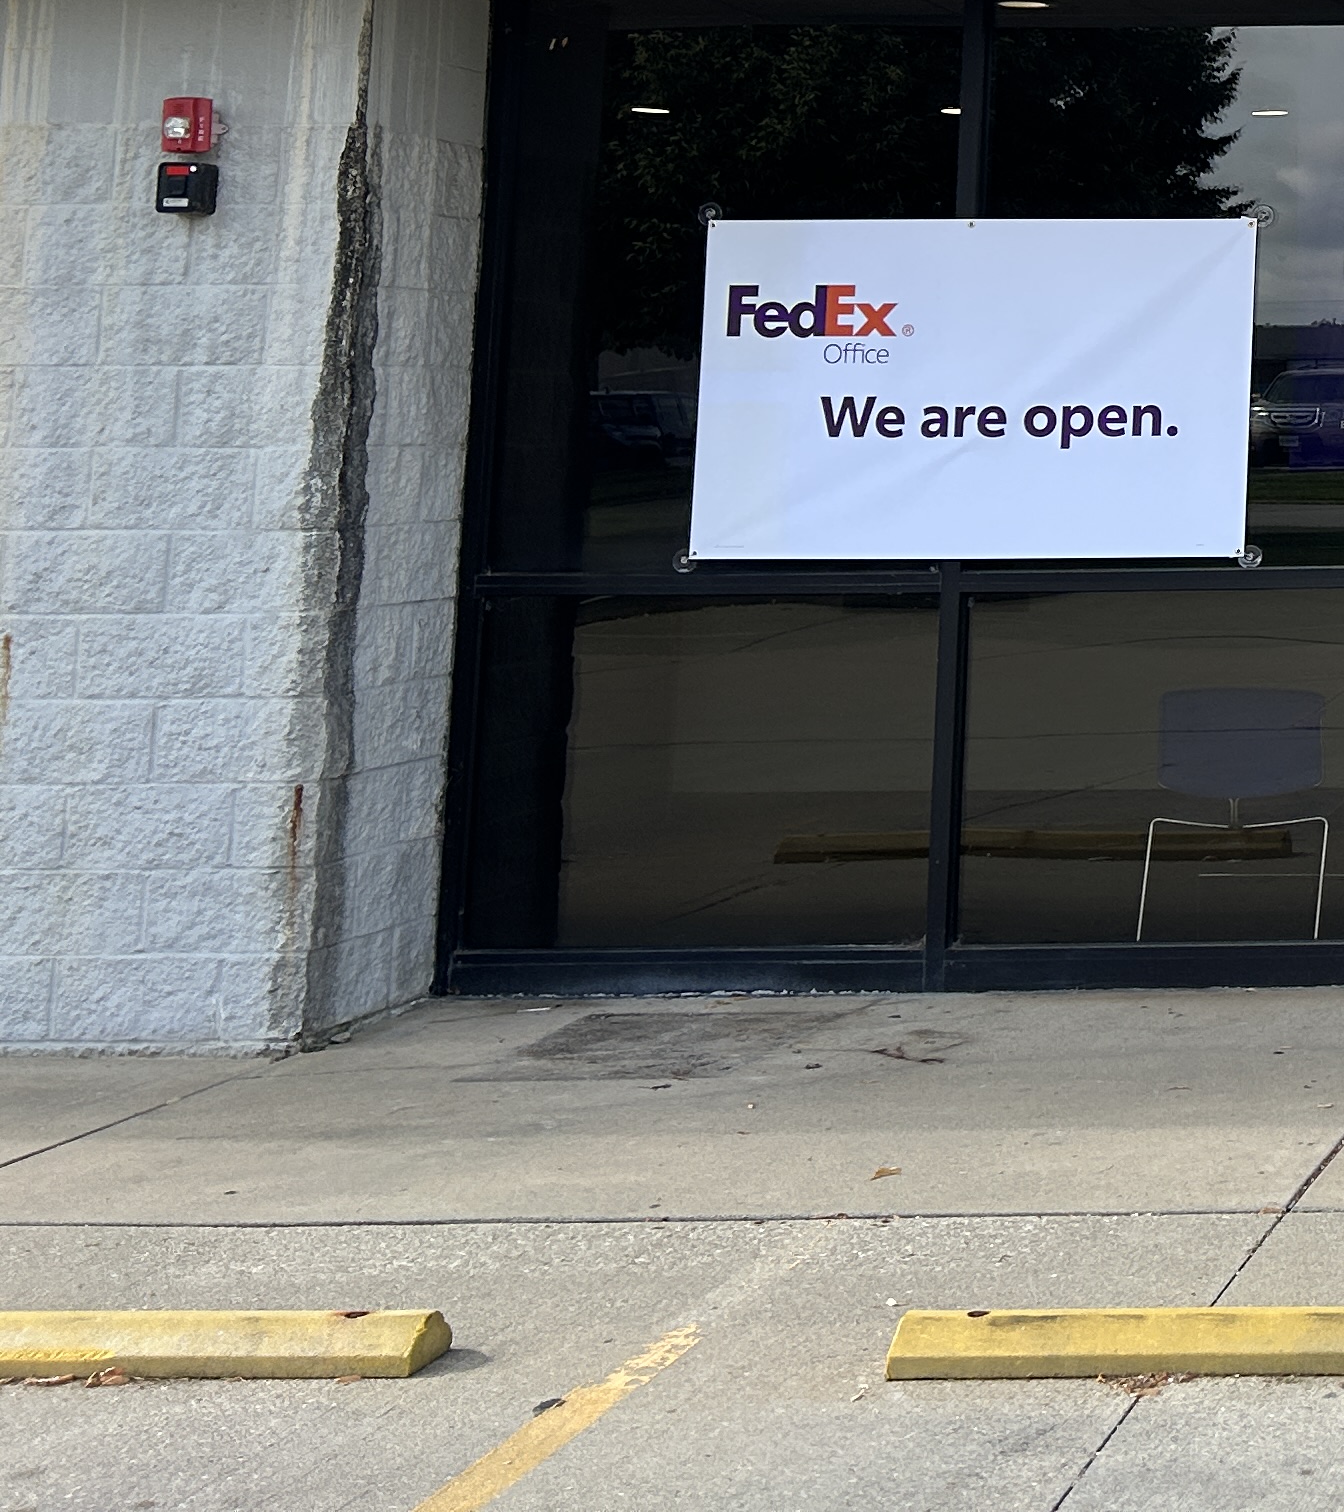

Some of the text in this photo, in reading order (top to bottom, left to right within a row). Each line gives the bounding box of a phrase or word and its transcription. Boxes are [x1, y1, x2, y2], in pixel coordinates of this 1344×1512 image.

[726, 284, 898, 337] FedEx
[822, 342, 890, 365] Office
[820, 396, 1179, 449] We are open.
